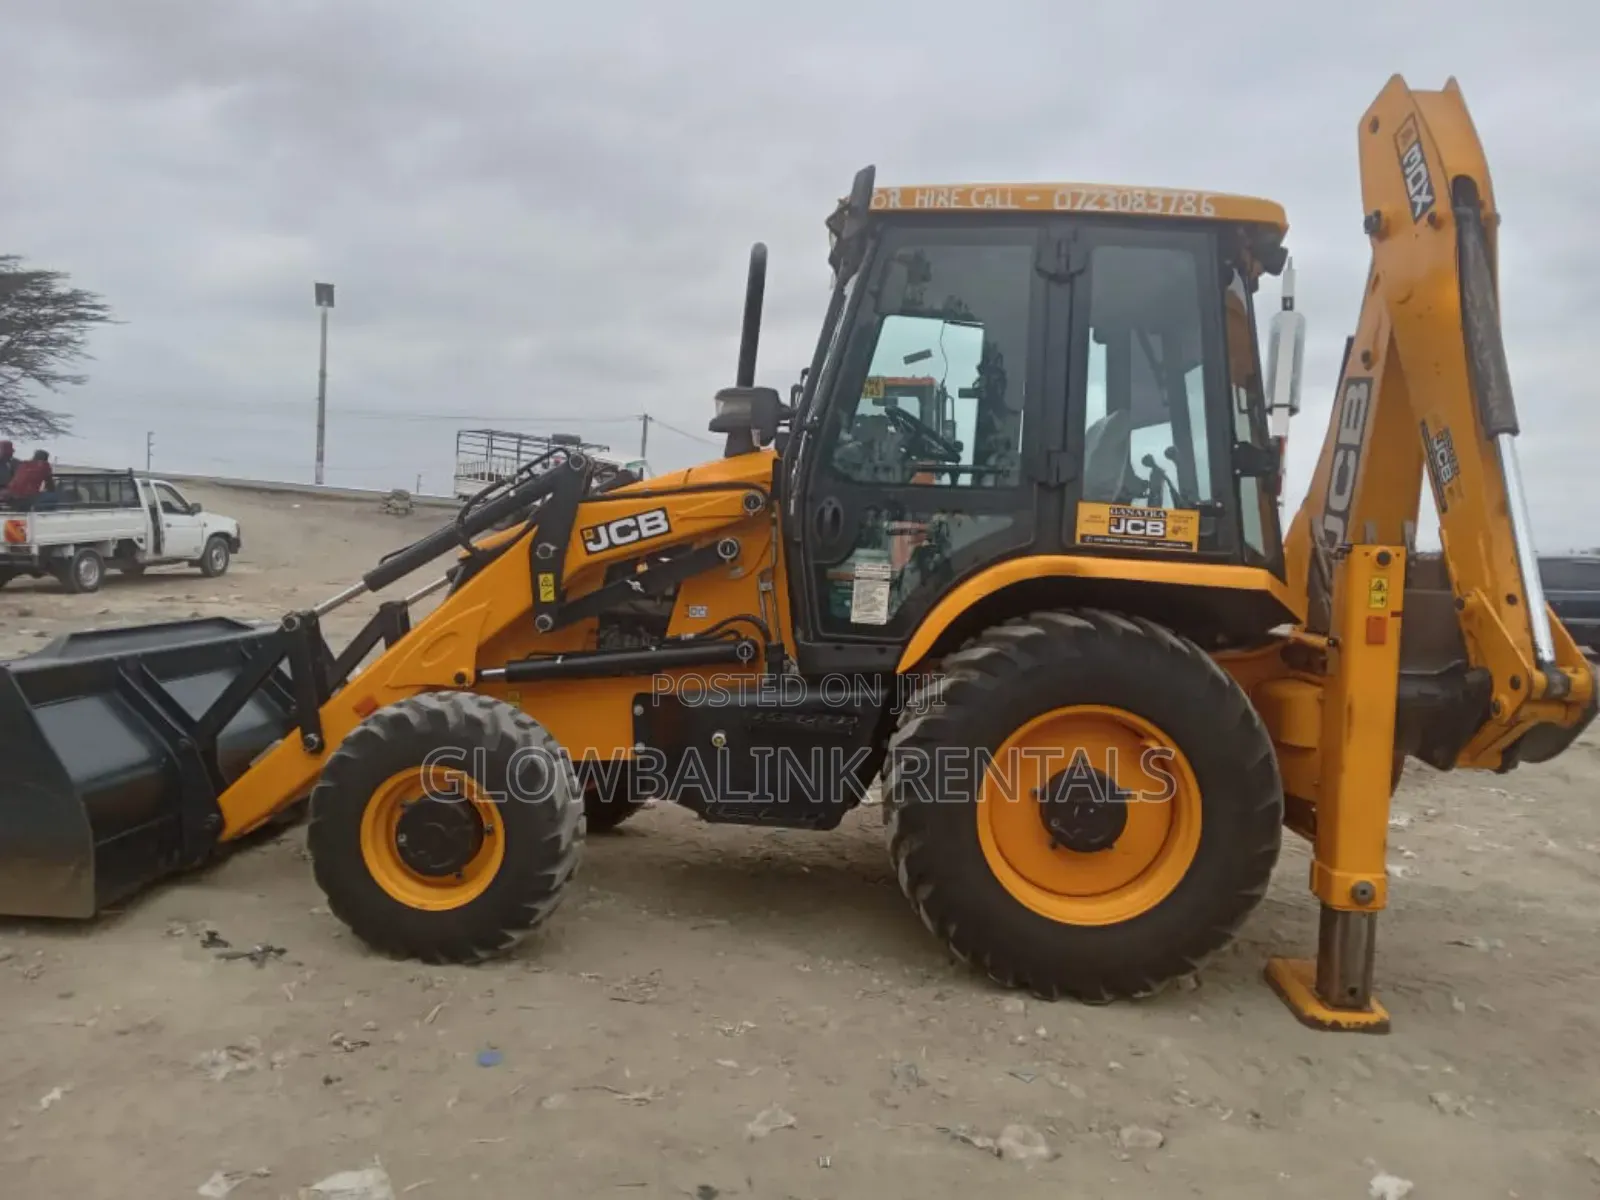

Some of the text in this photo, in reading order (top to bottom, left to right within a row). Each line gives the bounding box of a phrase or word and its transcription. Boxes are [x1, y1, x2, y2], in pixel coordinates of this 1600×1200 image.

[914, 187, 965, 209] HIRE
[970, 186, 1020, 209] CALL
[1053, 188, 1216, 217] 0723083786
[1402, 141, 1434, 219] 3DX
[1320, 381, 1369, 555] JCB
[1432, 436, 1453, 482] JCB
[585, 508, 670, 553] JCB
[1110, 518, 1165, 537] JCB
